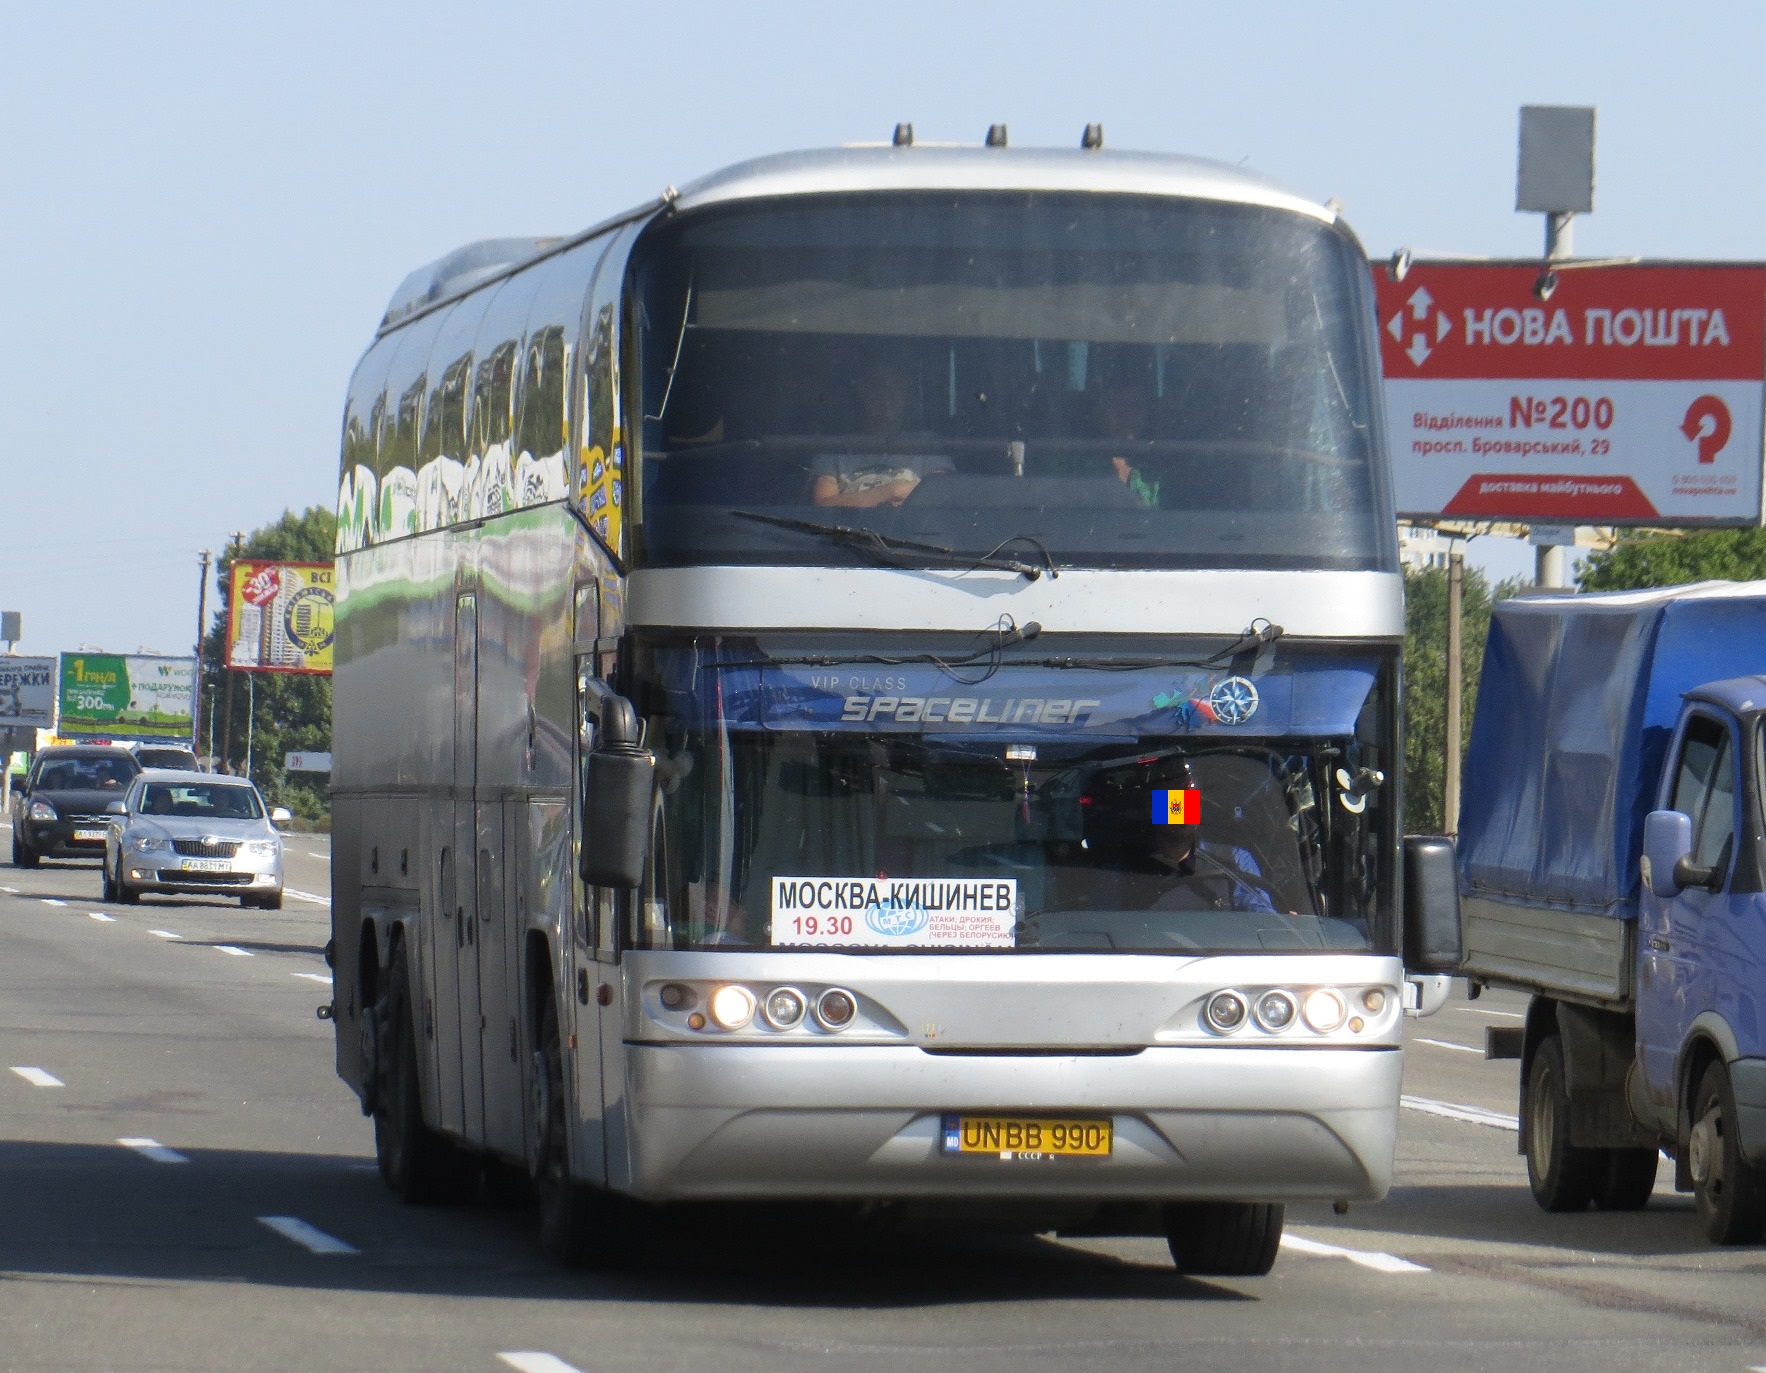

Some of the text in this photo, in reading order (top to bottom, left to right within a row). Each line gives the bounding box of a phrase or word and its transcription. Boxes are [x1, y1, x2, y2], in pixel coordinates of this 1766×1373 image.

[1464, 307, 1730, 347] НОВА ПОШТА
[1413, 395, 1614, 430] Відділення №200
[1412, 437, 1610, 457] просп. Броварський, 29
[1480, 481, 1537, 495] доставка
[810, 676, 907, 690] VIP CLASS
[779, 881, 1011, 911] МОСКВА-КИШИНЕВ
[792, 916, 853, 936] 19.30
[946, 1136, 959, 1147] MD
[1051, 1123, 1102, 1151] 990
